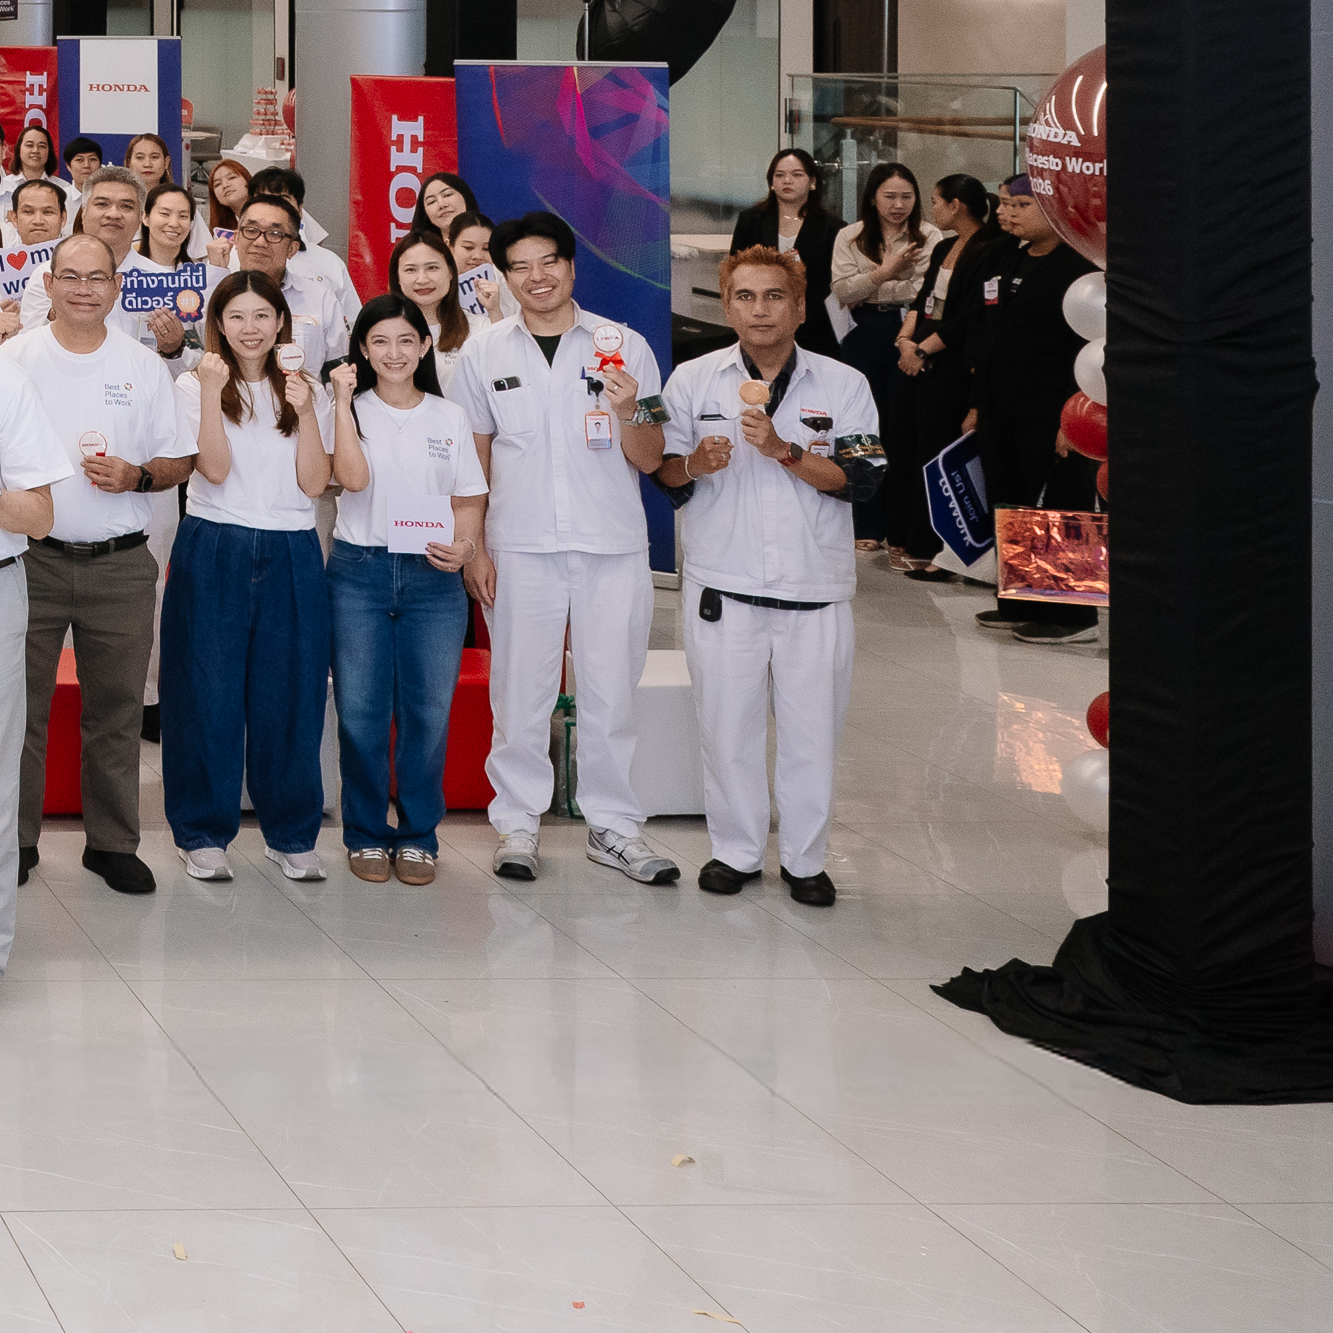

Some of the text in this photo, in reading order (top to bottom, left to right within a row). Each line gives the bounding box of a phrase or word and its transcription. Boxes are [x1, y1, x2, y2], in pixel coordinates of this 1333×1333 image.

[89, 84, 150, 92] HONDA
[125, 292, 174, 308] ดีเวอร์
[963, 496, 978, 522] Join
[394, 520, 445, 529] HONDA
